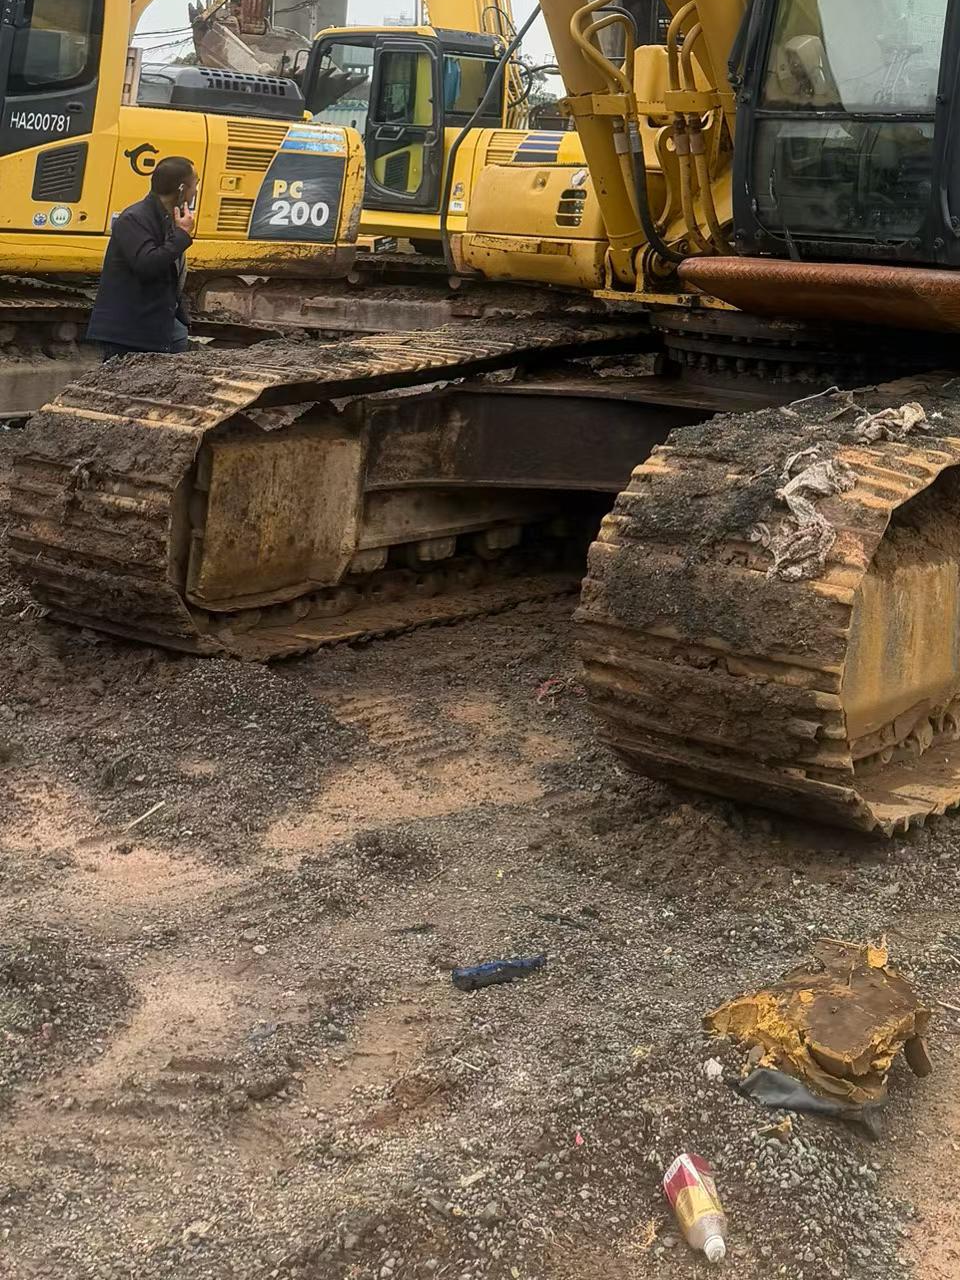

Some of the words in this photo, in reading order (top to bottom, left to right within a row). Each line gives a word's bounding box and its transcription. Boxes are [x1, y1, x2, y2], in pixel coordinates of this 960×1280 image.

[10, 111, 71, 133] HA200781
[272, 179, 304, 199] PC
[269, 200, 330, 227] 200
